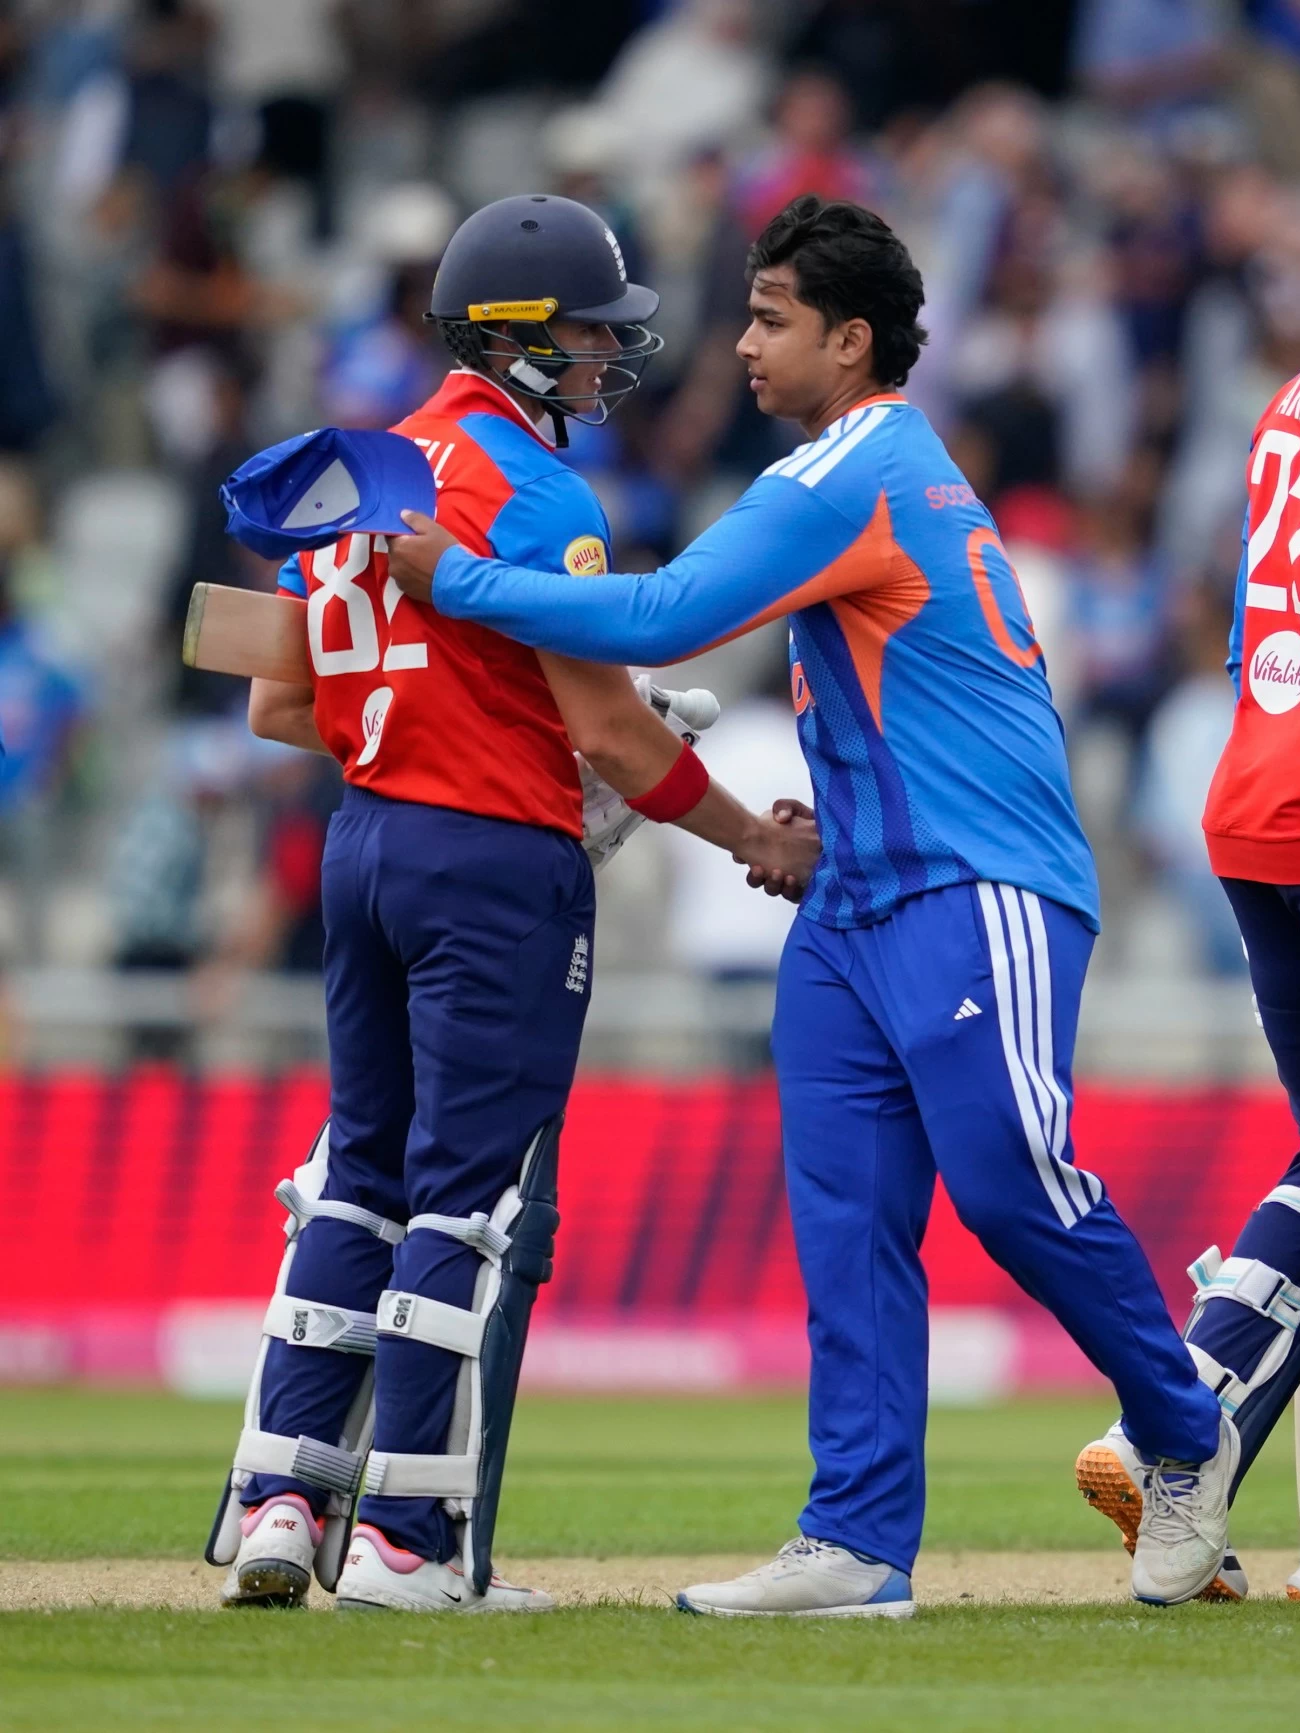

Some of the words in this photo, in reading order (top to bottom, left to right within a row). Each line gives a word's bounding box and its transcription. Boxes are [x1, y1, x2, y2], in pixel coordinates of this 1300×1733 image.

[573, 547, 600, 571] HULA
[292, 1310, 309, 1341] GM
[393, 1298, 412, 1328] GM
[270, 1519, 298, 1531] NIKE
